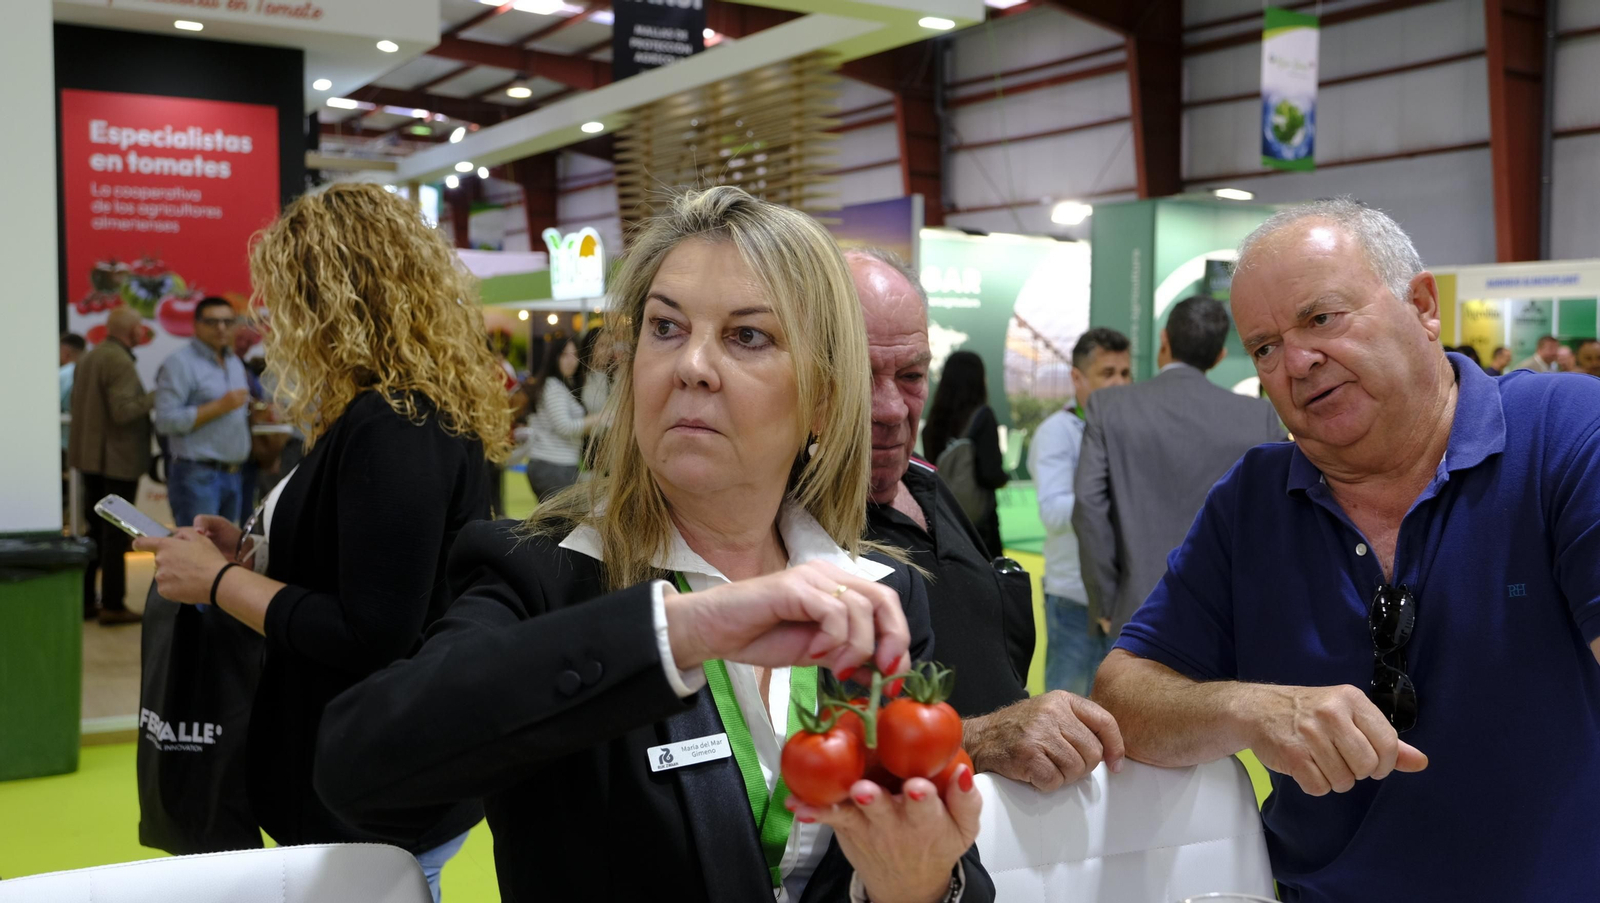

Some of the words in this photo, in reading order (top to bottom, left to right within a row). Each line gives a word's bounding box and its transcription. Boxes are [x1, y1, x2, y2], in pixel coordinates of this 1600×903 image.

[89, 119, 253, 154] Especialistas
[89, 152, 123, 172] en
[126, 149, 232, 179] tomates
[90, 181, 112, 197] La
[113, 184, 202, 202] cooperativa
[90, 198, 112, 214] de
[113, 200, 136, 216] los
[137, 203, 223, 219] agricultores
[91, 215, 180, 234] almerienses
[164, 744, 204, 752] INNOVATION
[681, 744, 699, 752] María
[692, 748, 717, 758] Gimeno
